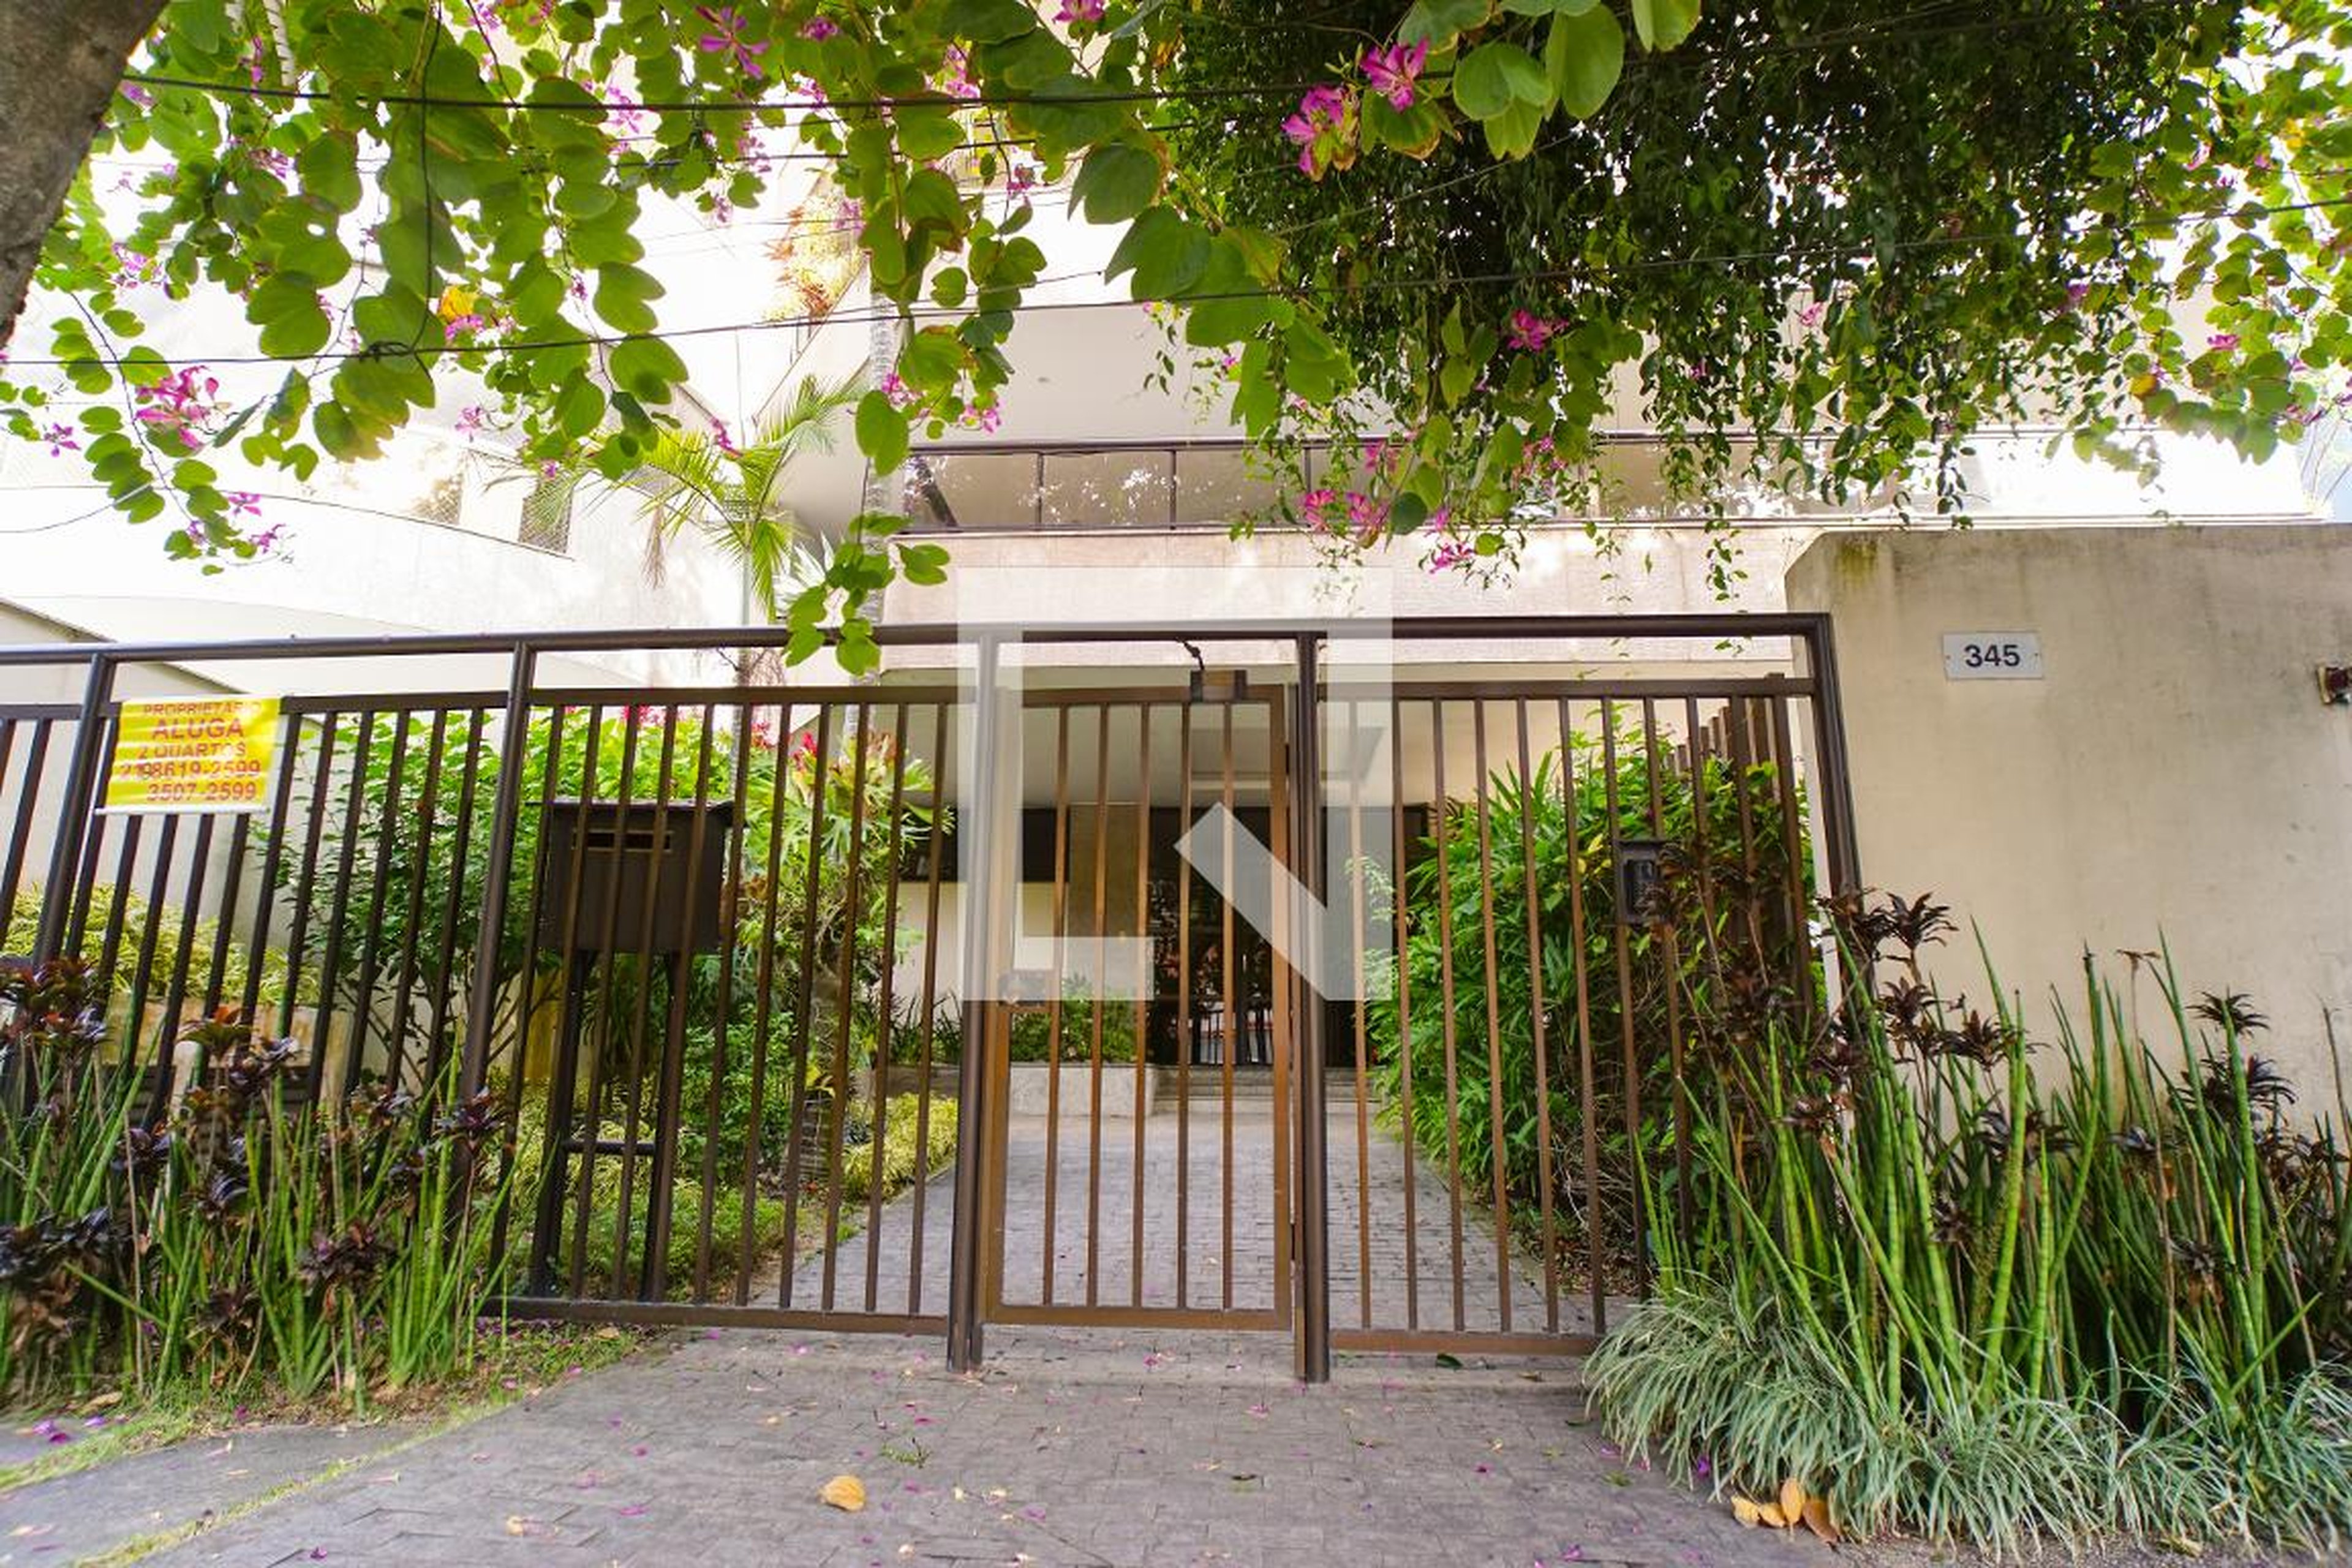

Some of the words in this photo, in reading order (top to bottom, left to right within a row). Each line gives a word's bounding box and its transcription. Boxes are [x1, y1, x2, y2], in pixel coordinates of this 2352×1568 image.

[1964, 644, 2021, 668] 345
[144, 701, 262, 715] PROPRIETARO
[153, 717, 244, 739] ALUGA
